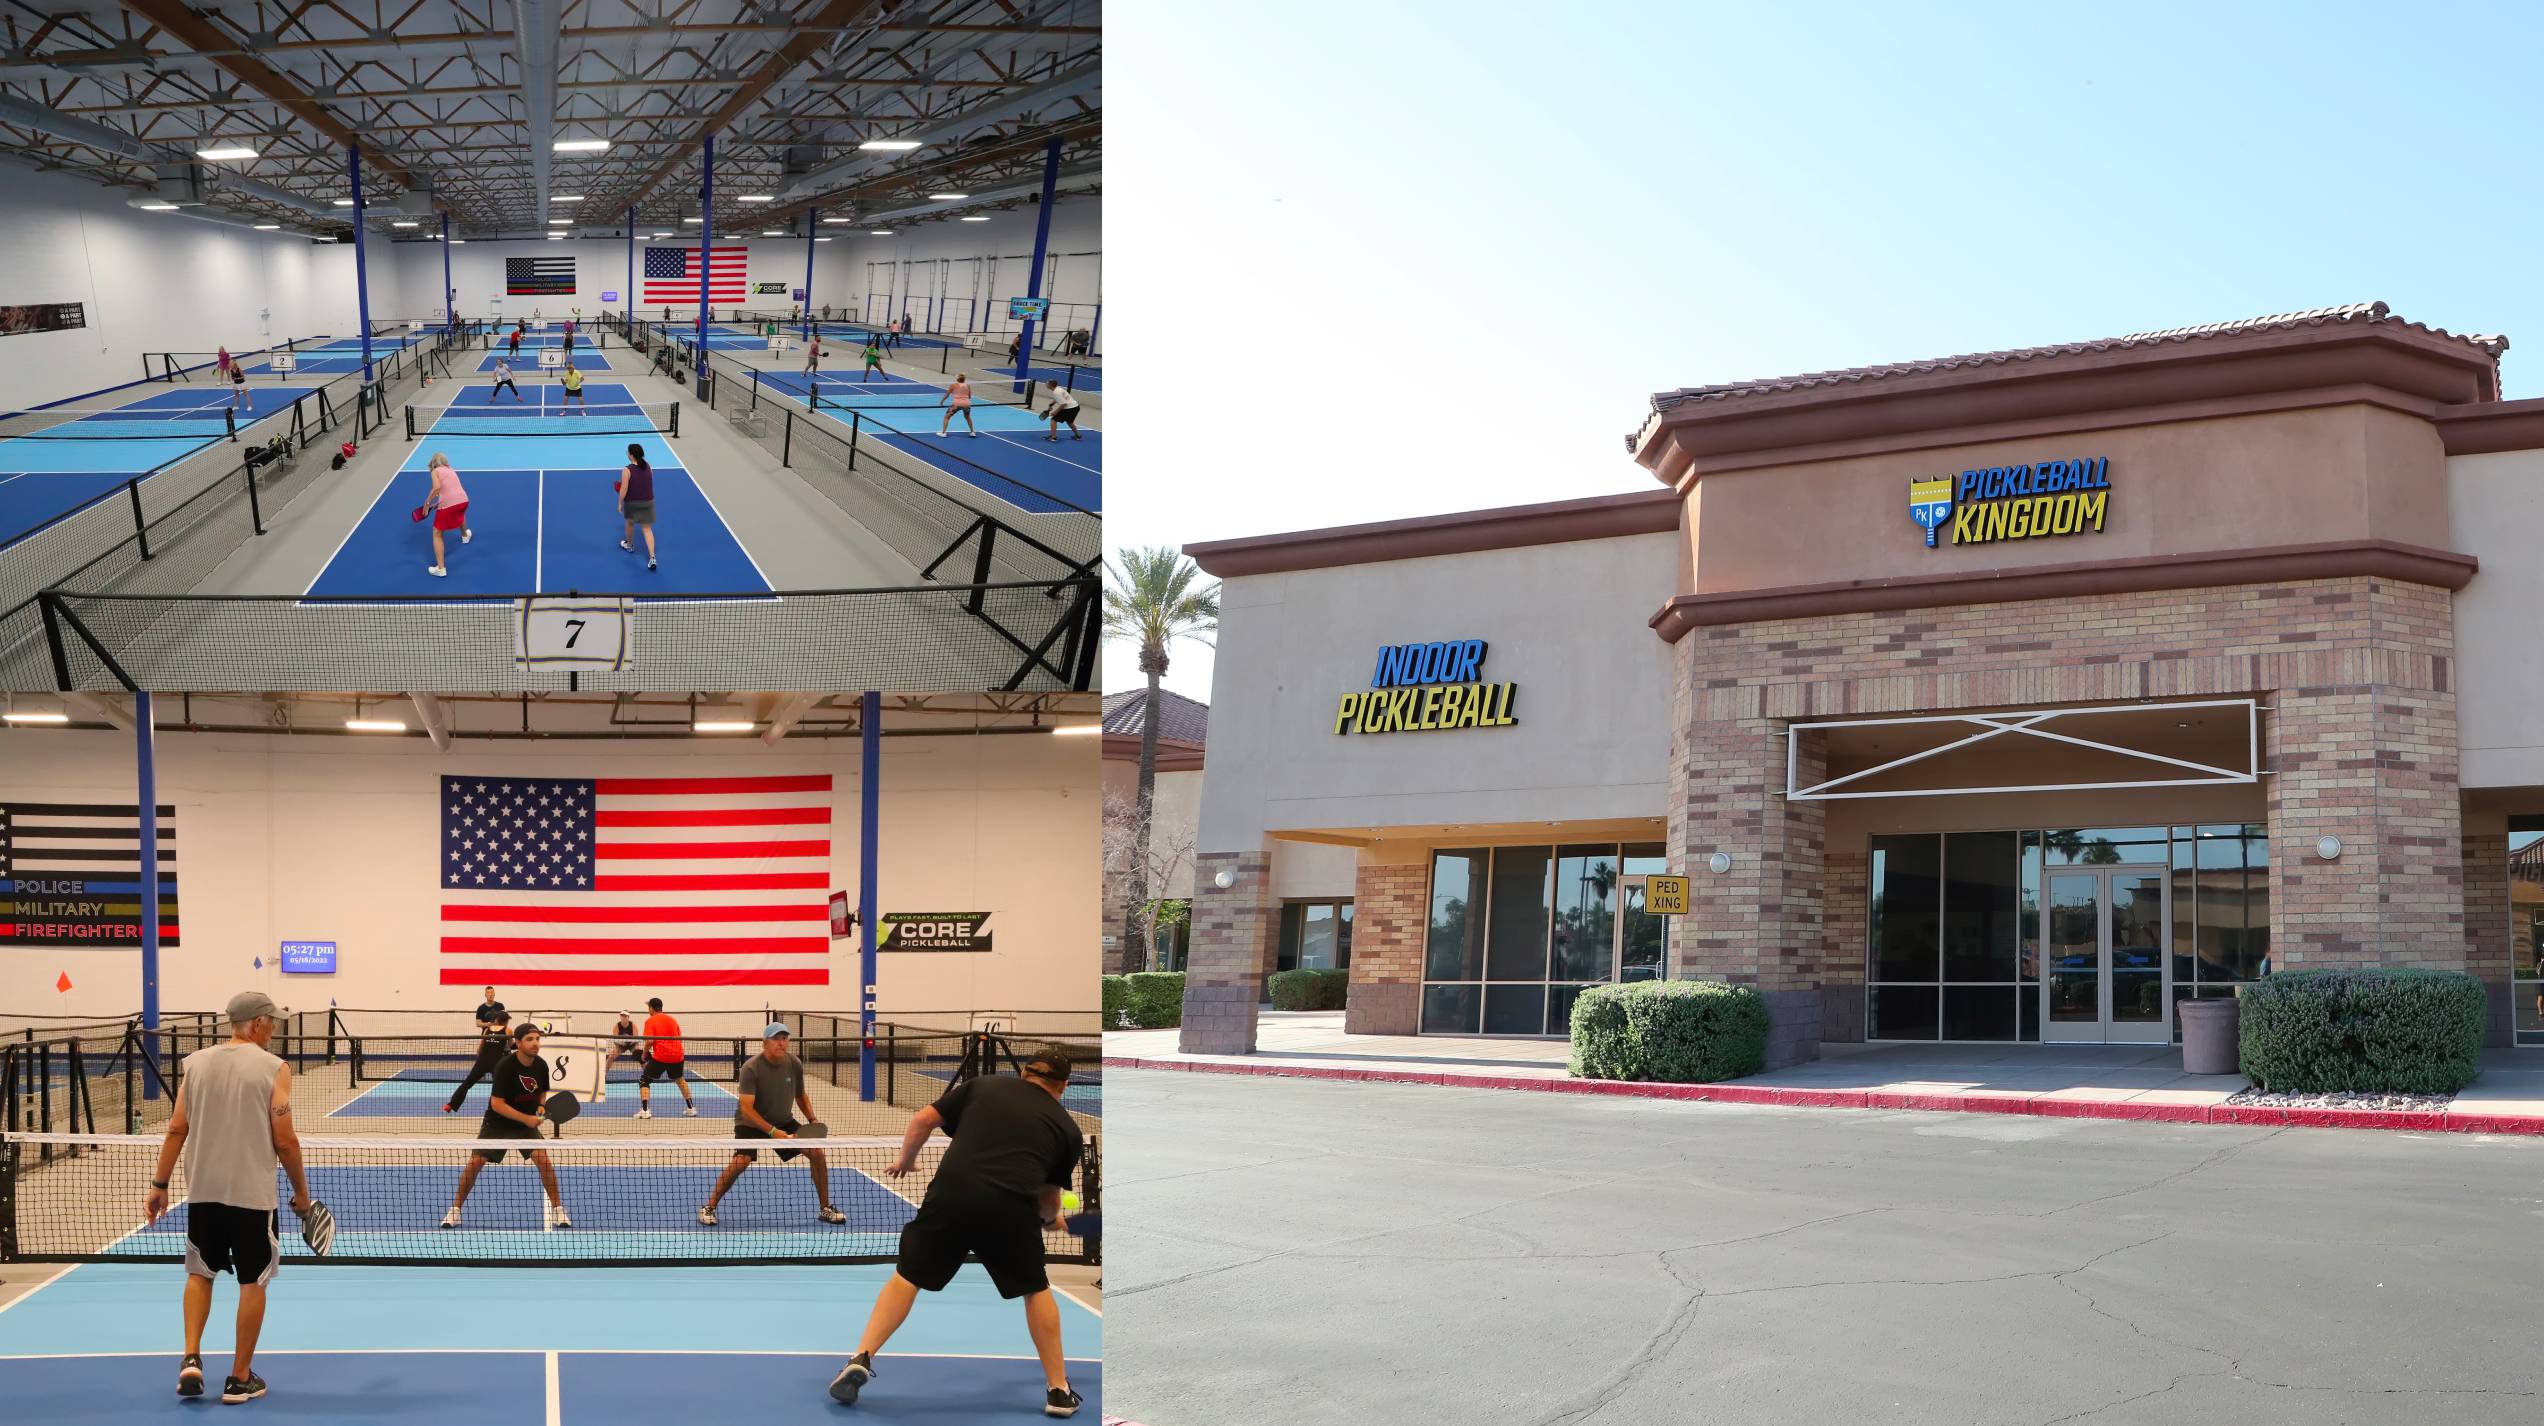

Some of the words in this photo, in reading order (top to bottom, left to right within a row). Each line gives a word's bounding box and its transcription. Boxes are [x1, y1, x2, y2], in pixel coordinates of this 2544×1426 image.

[279, 357, 285, 366] 2
[549, 354, 555, 363] 6
[1958, 456, 2112, 502] PICKLEBALL
[1916, 508, 1928, 522] PK
[1952, 491, 2110, 547] KINGDOM
[565, 620, 586, 649] 7
[1370, 639, 1488, 688] INDOOR
[1334, 682, 1519, 735] PICKLEBALL
[14, 879, 83, 895] POLICE
[1656, 881, 1679, 893] PED
[15, 901, 103, 917] MILITARY
[1654, 896, 1681, 909] XING
[15, 923, 138, 938] FIREFIGHTER
[900, 922, 971, 938] CORE
[283, 945, 314, 956] 05:27
[316, 946, 335, 957] pm
[900, 939, 971, 947] PICKLEBALL
[551, 1055, 570, 1082] 8
